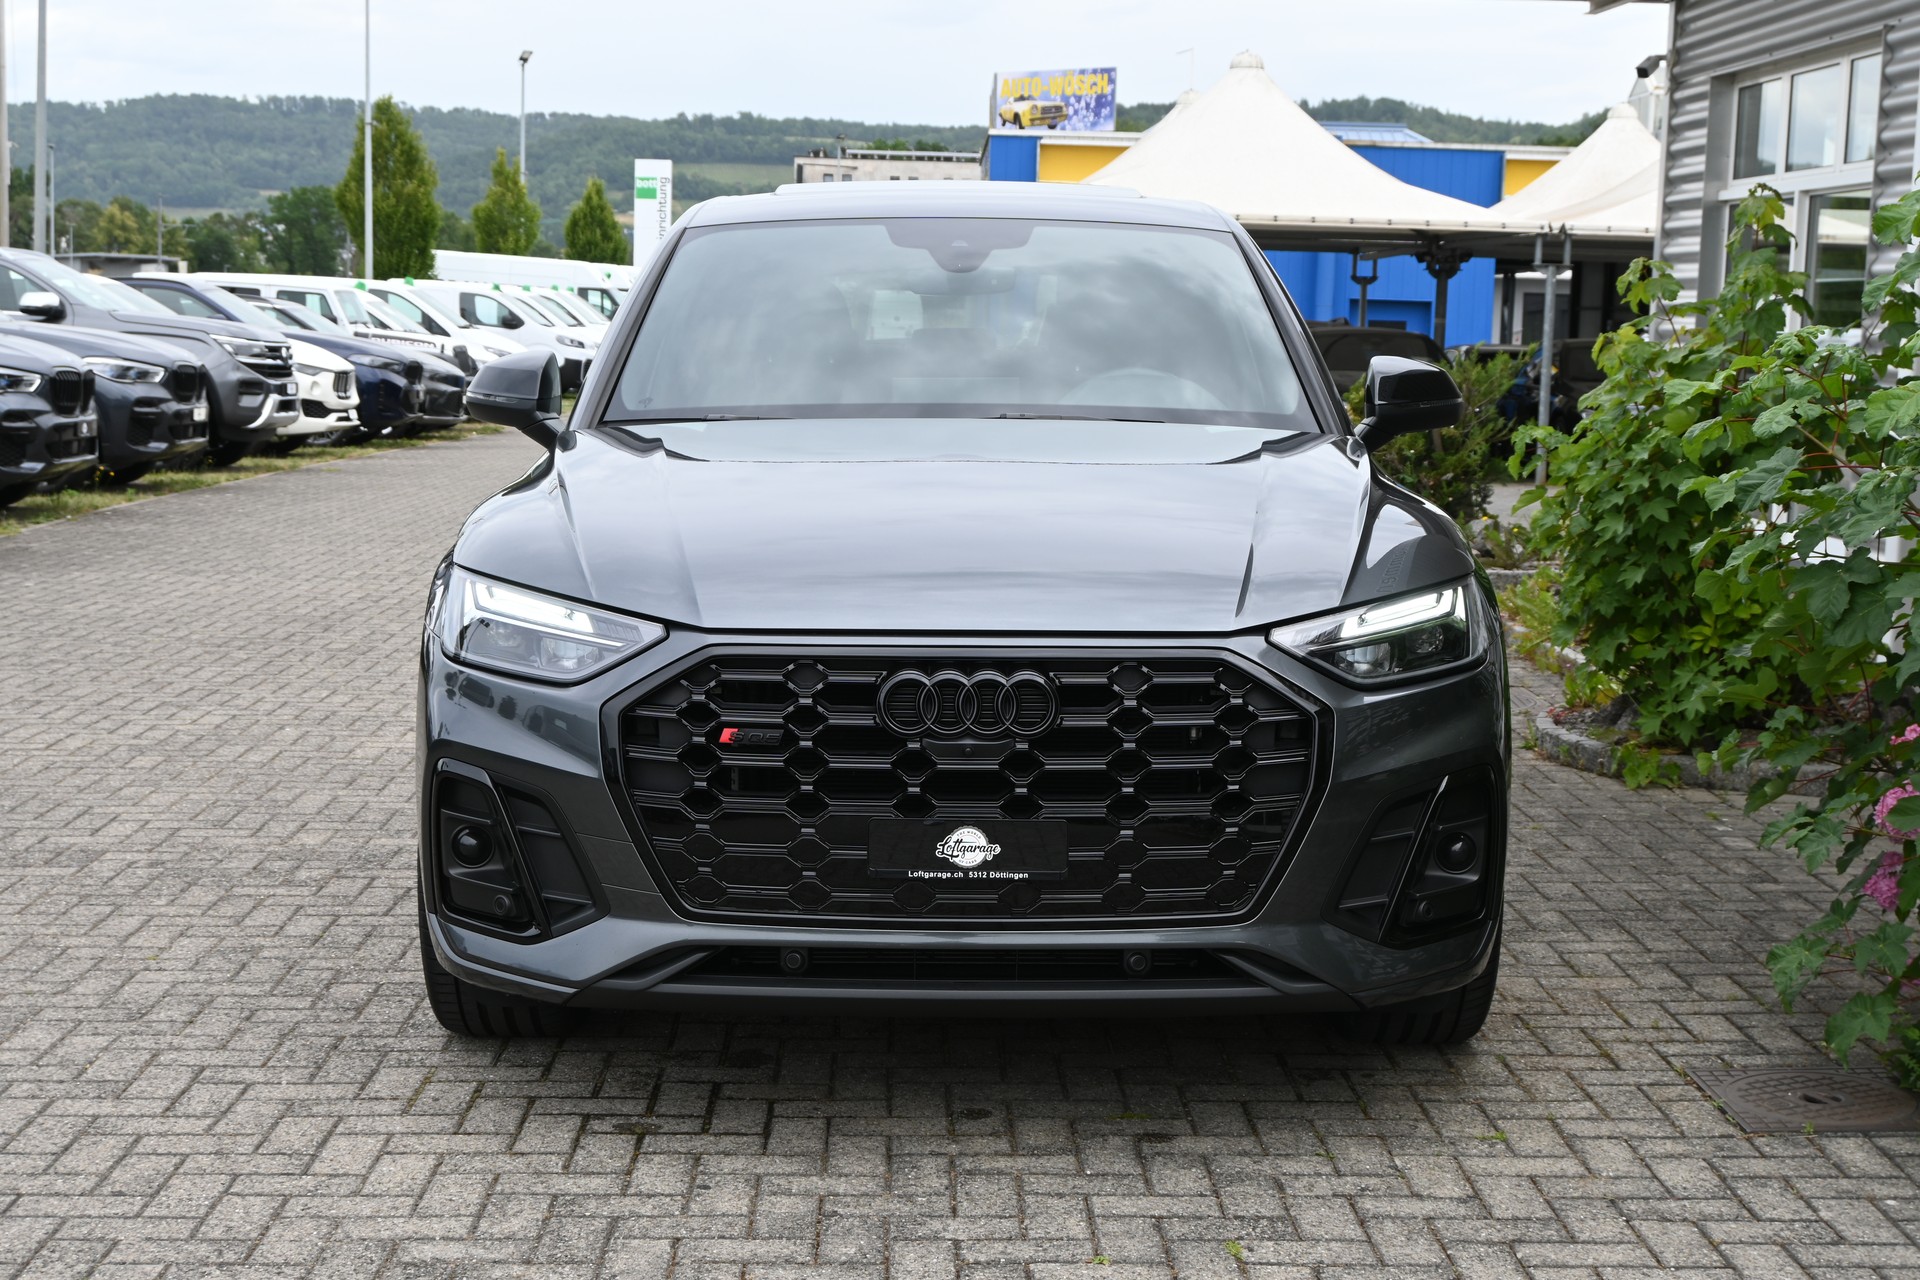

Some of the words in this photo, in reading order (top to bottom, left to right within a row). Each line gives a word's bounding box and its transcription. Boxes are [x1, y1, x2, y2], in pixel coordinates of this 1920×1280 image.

[1001, 70, 1108, 98] AUTO-WÖSCH
[729, 731, 781, 744] SQ5
[937, 836, 999, 860] Loftgarage
[908, 870, 964, 879] Loftgarage.ch
[989, 871, 1029, 880] Döttingen
